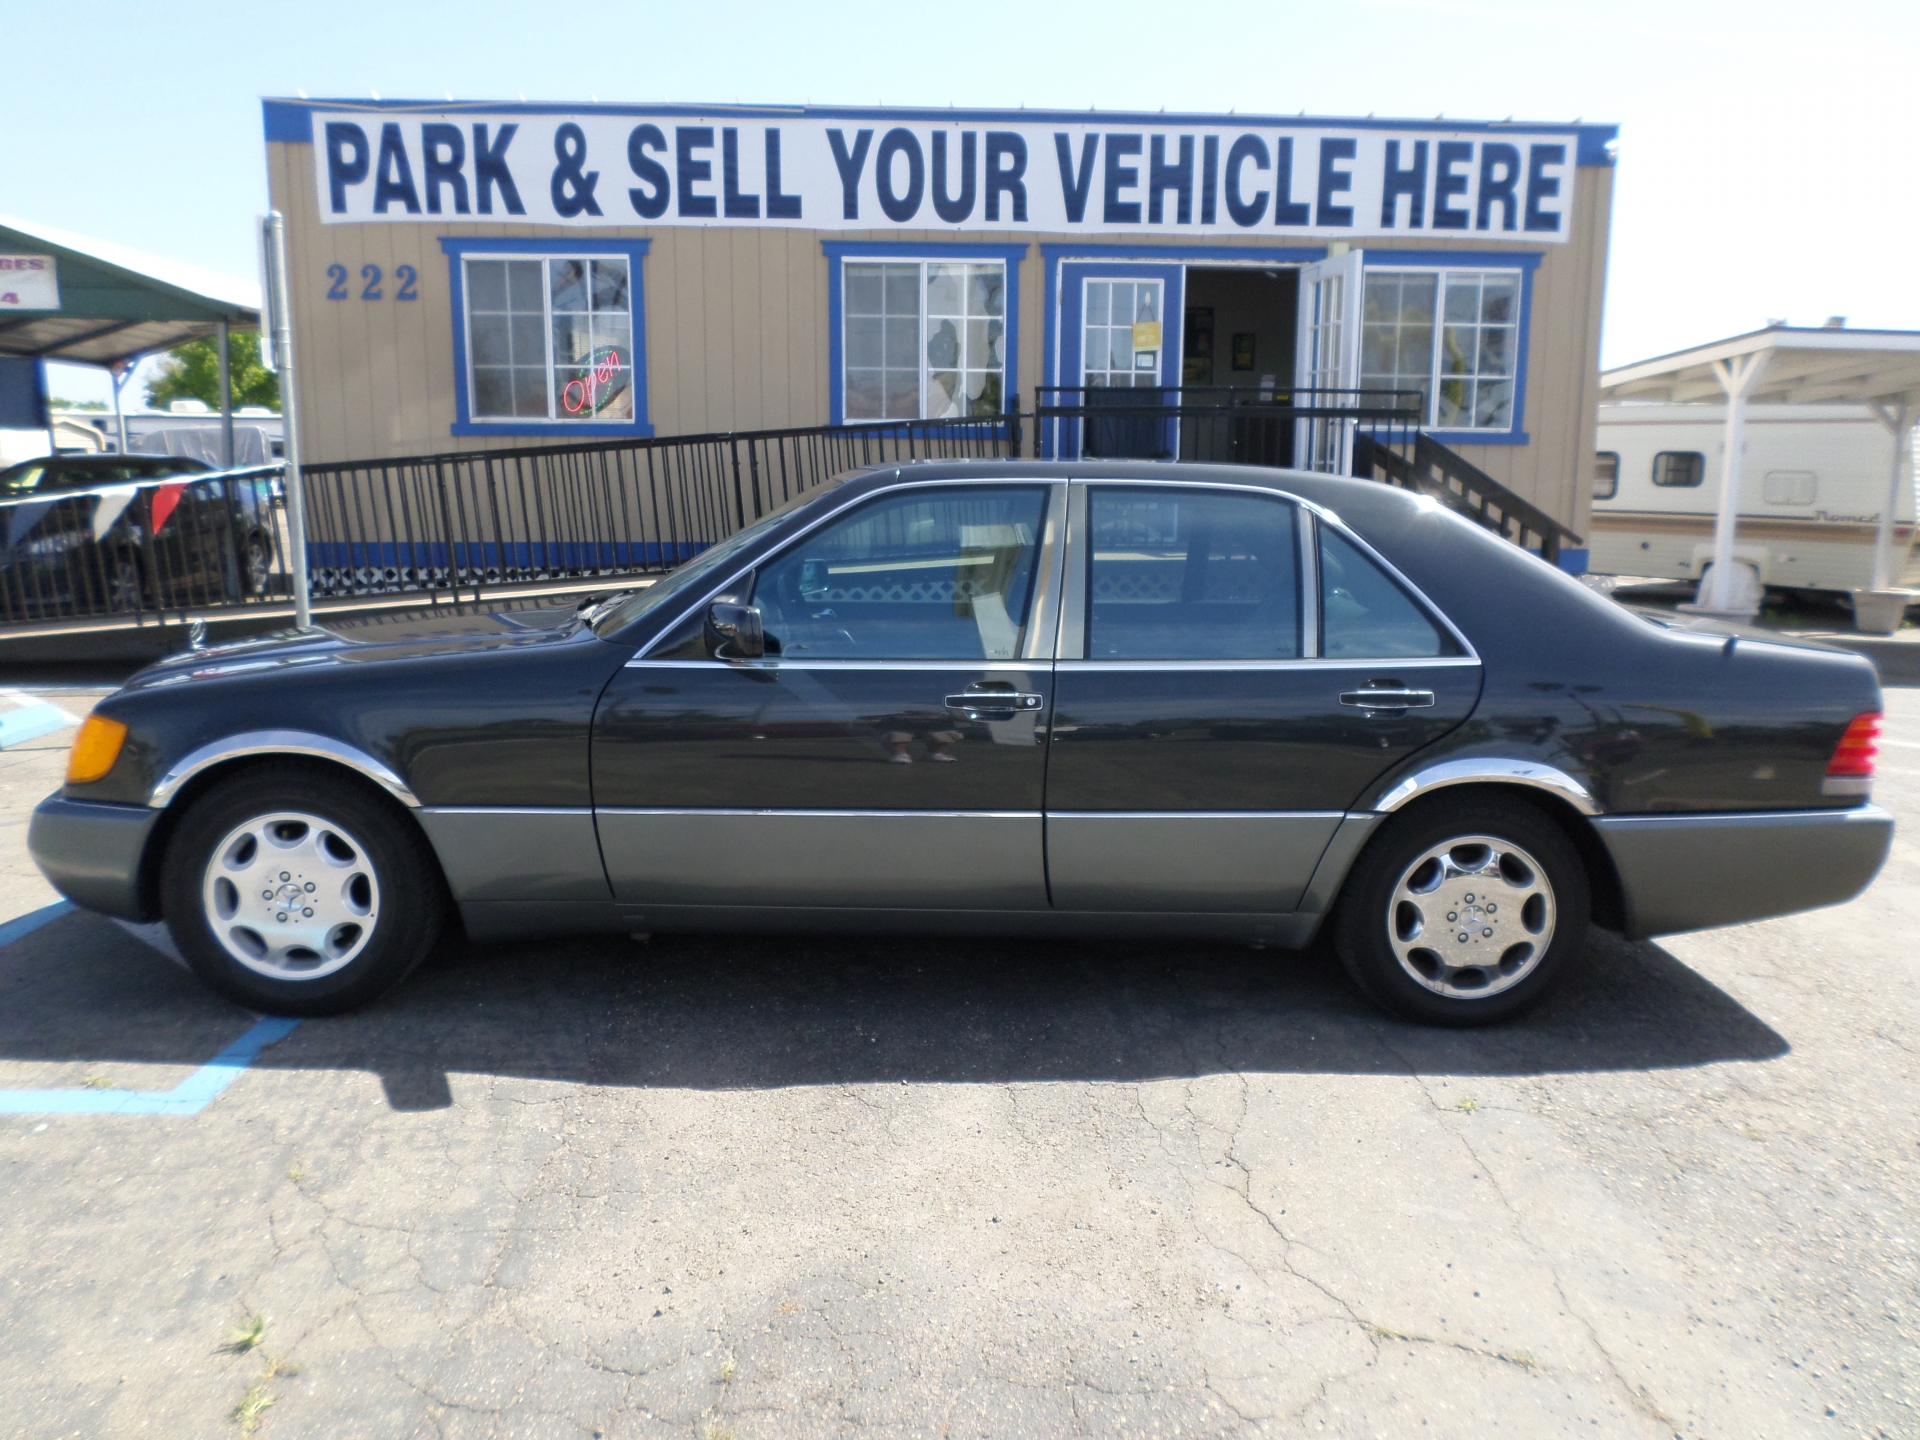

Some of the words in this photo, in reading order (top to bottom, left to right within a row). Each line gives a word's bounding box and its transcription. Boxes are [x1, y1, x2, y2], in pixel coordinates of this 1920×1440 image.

[326, 122, 525, 215] PARK
[550, 124, 603, 218] &
[628, 124, 802, 219] SELL
[827, 130, 1028, 224] YOUR
[1055, 134, 1354, 228] VEHICLE
[1380, 141, 1562, 232] HERE
[326, 263, 418, 301] 222
[563, 350, 621, 413] Open
